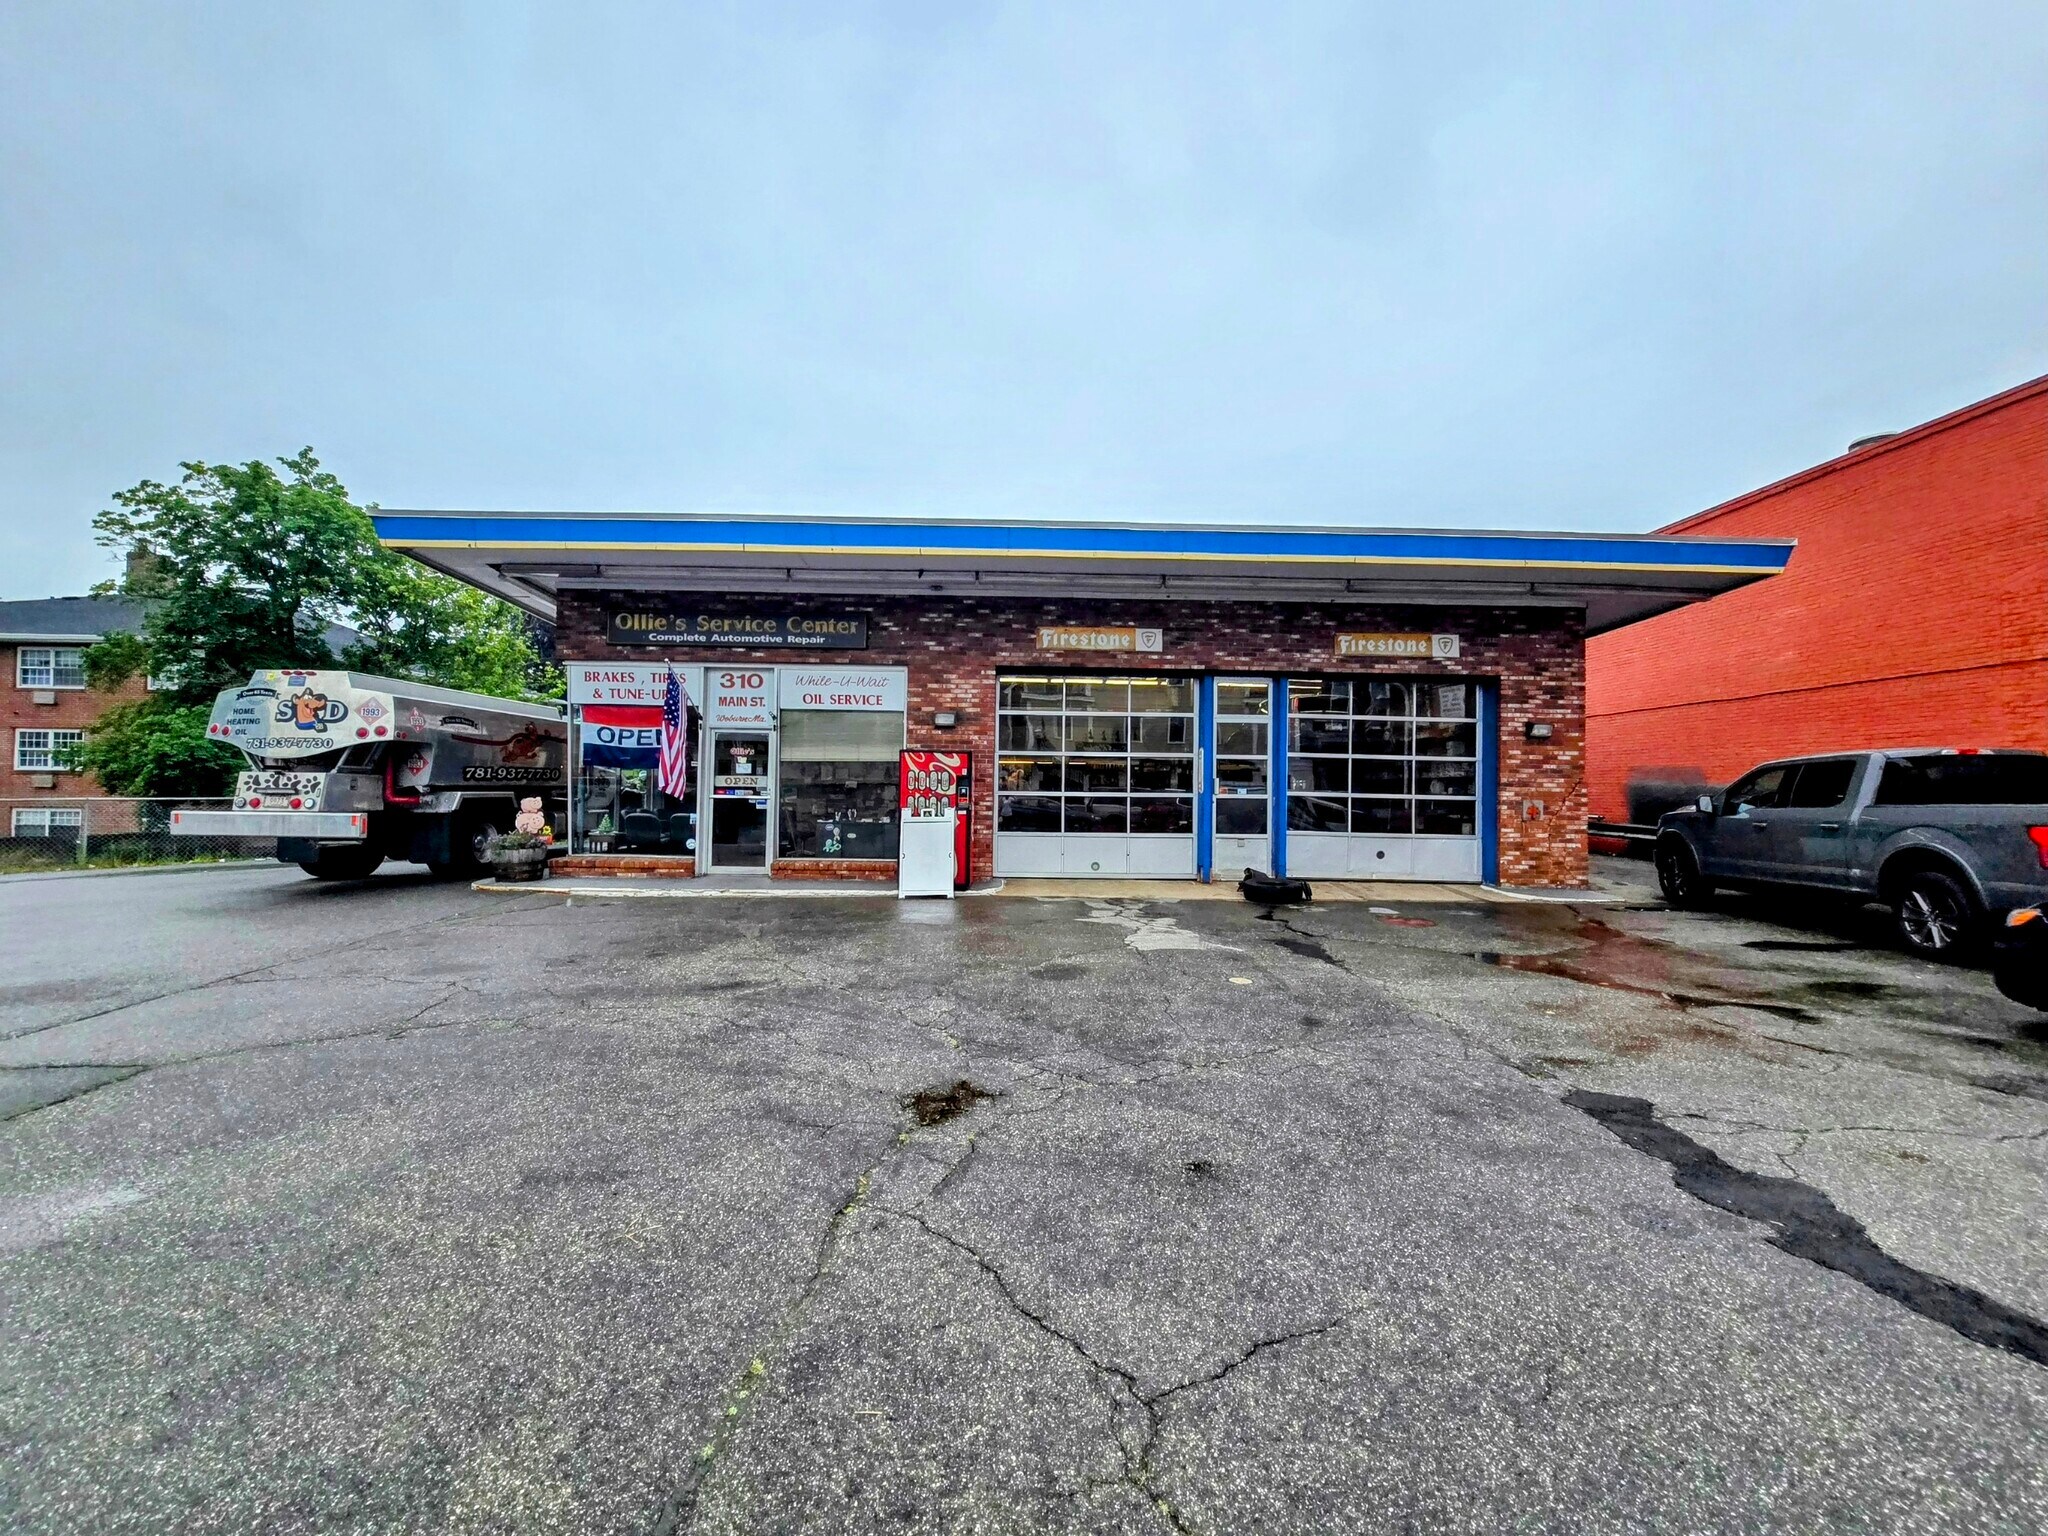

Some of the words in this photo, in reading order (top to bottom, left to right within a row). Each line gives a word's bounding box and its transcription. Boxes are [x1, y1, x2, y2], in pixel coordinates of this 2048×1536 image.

[615, 612, 687, 632] Ollie's
[696, 614, 777, 633] Service
[786, 616, 859, 634] Center
[648, 632, 707, 643] Complete
[710, 633, 783, 644] Automotive
[787, 635, 826, 645] Repair
[1039, 629, 1131, 648] Firestone
[1337, 635, 1428, 654] Firestone
[650, 672, 686, 684] TIRS
[719, 672, 764, 689] 310
[795, 674, 889, 687] While-U-Wait
[592, 687, 603, 699] &
[802, 693, 825, 704] OIL
[829, 693, 883, 705] SERVICE
[718, 696, 748, 707] MAIN
[750, 696, 766, 707] ST.
[232, 707, 256, 715] HOME
[361, 708, 381, 717] 1993
[226, 717, 261, 725] HEATING
[234, 728, 248, 736] OIL
[245, 736, 334, 749] 781-937-7730
[465, 767, 559, 779] 781-937-7730
[724, 777, 759, 786] OPEN
